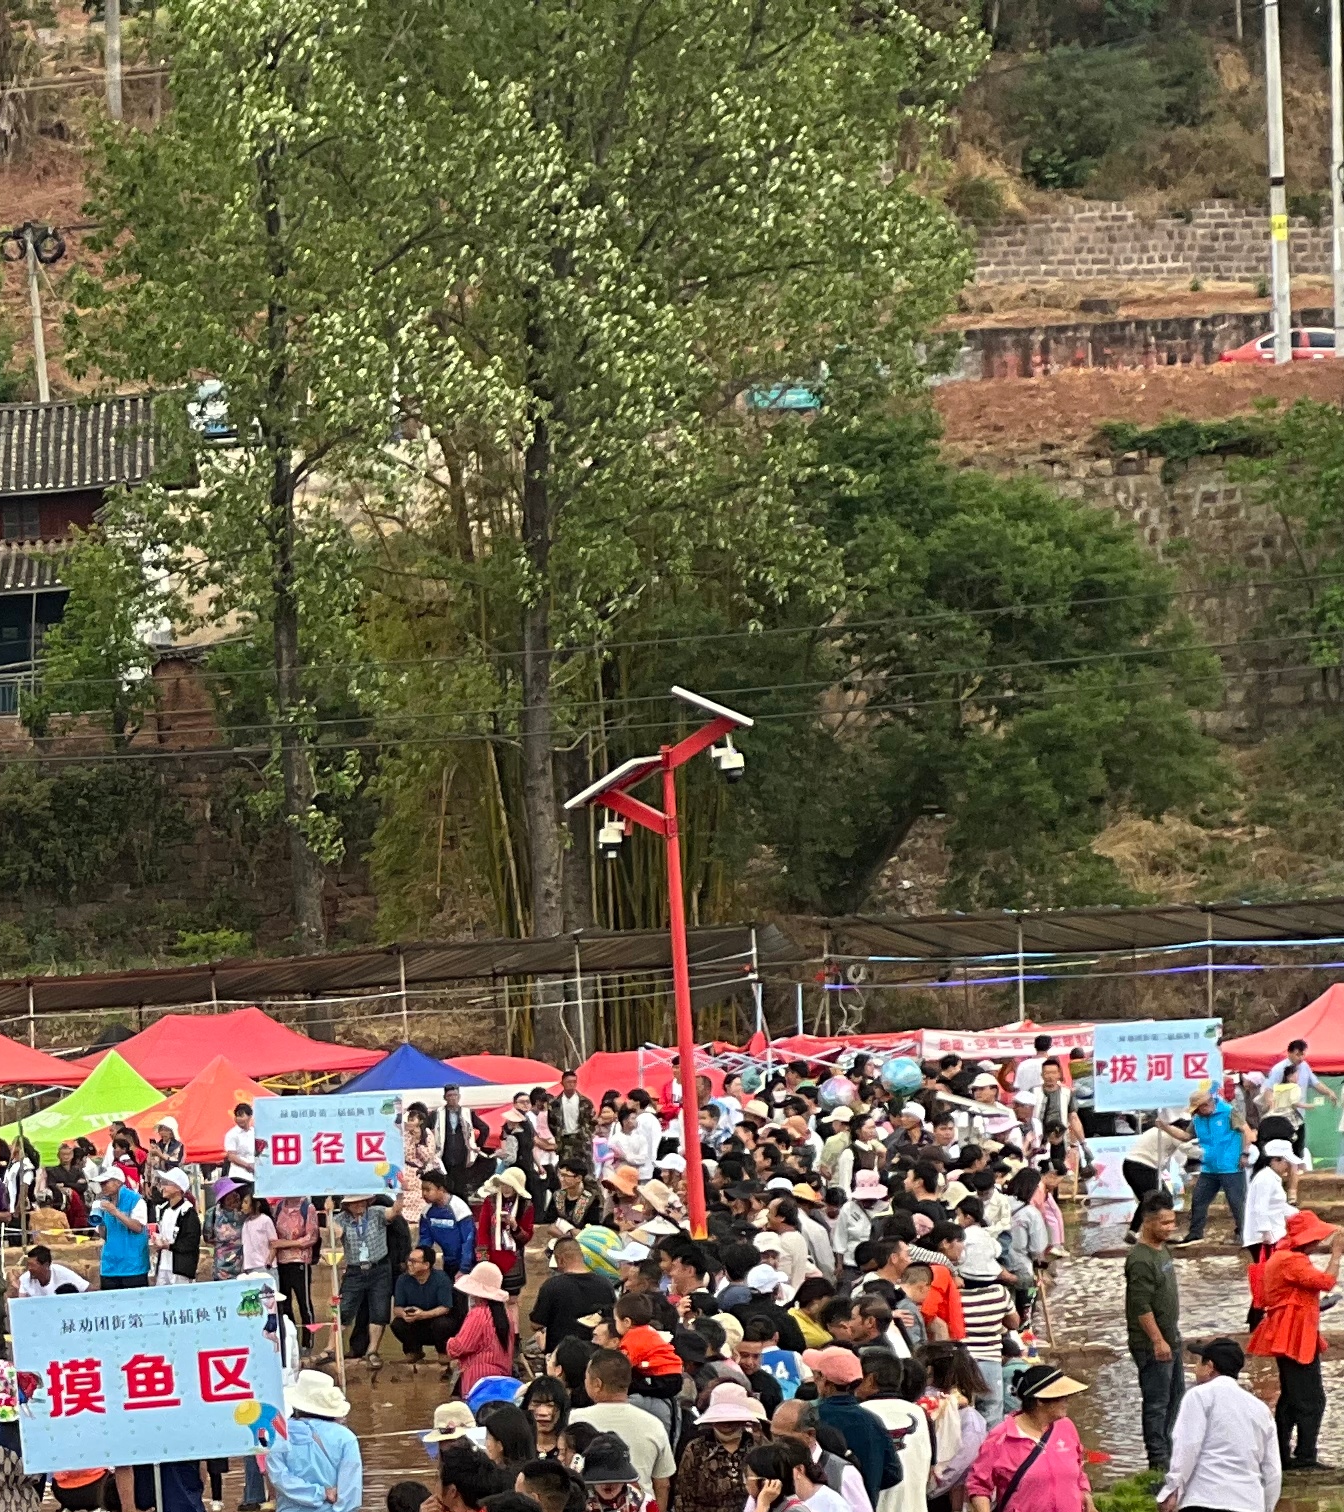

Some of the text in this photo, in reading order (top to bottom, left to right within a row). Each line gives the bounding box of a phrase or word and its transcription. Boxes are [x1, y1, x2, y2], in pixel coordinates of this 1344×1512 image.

[1109, 1052, 1210, 1083] 拔河区
[271, 1131, 387, 1166] 田径区
[61, 1306, 227, 1334] 禄劝团街第二届插秧节
[46, 1347, 254, 1418] 摸鱼区
